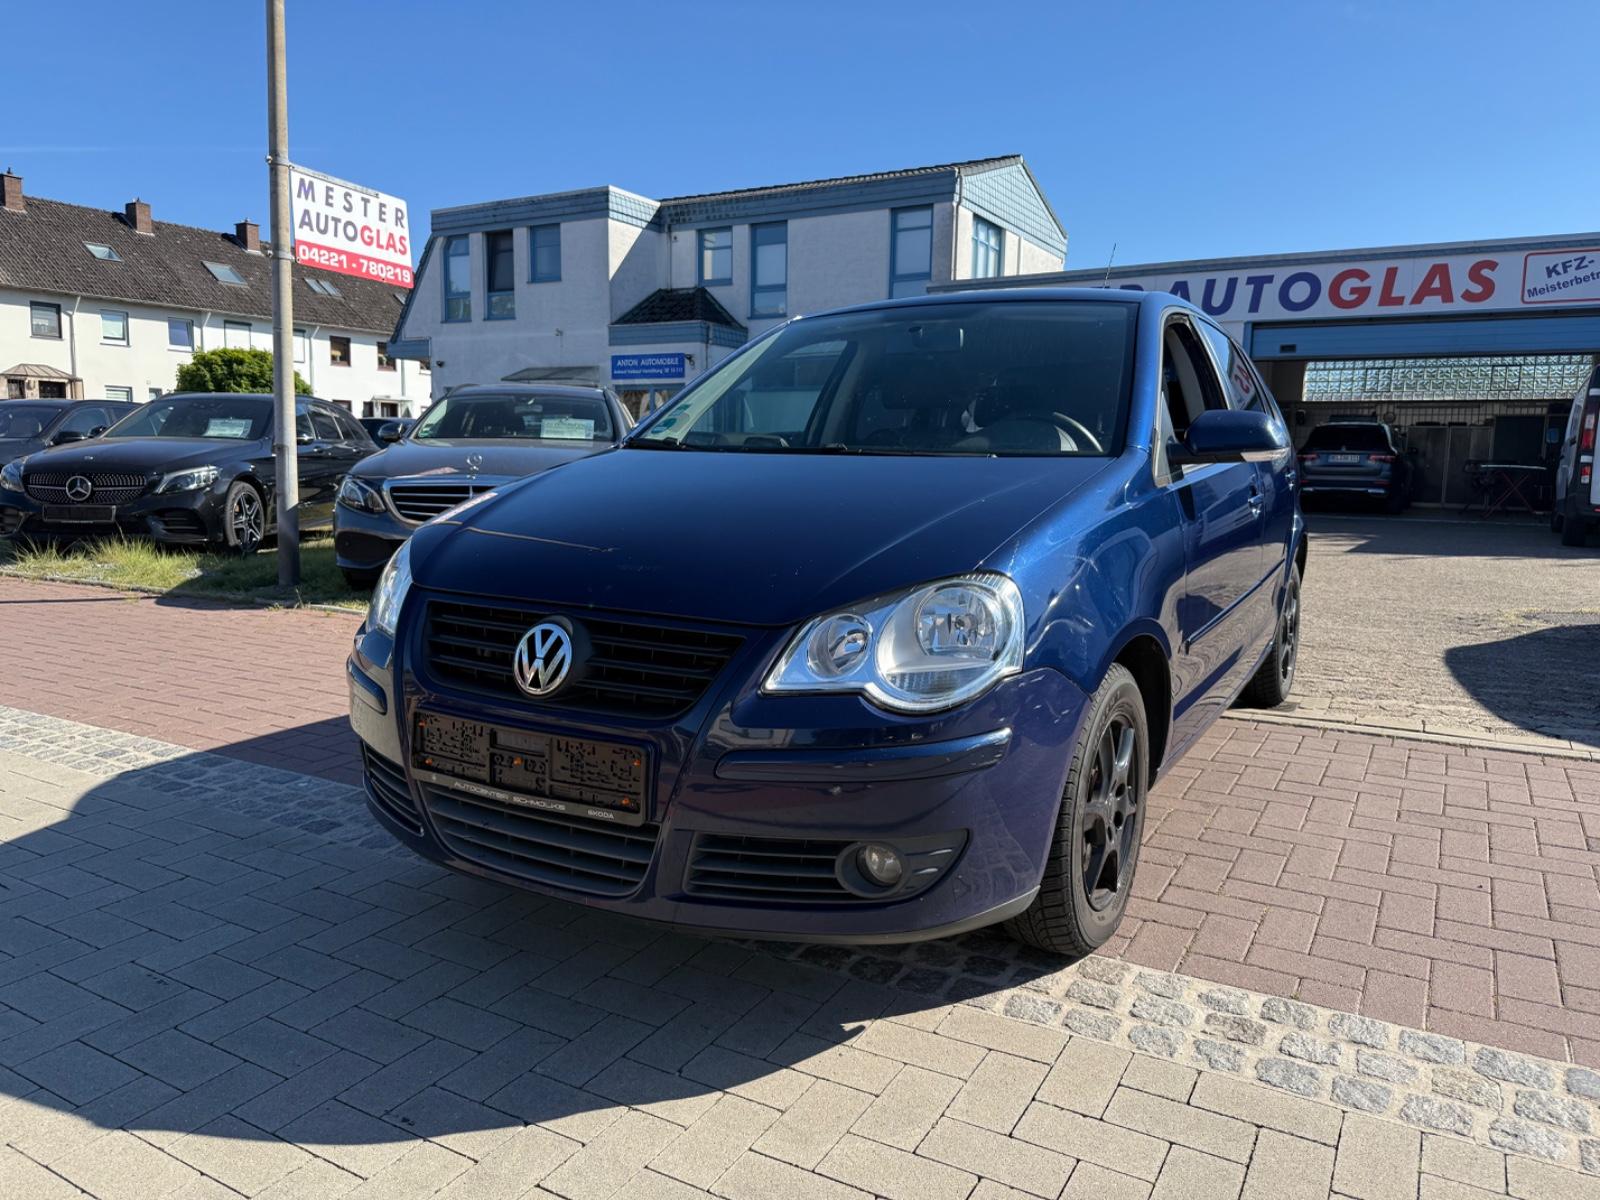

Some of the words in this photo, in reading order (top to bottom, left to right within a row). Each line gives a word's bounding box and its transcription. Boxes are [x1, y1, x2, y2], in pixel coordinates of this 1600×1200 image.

[297, 177, 405, 229] MESTER
[299, 208, 408, 256] AUTOGLAS
[299, 244, 348, 269] 04221
[359, 258, 411, 283] 780219
[1545, 255, 1595, 279] KFZ-
